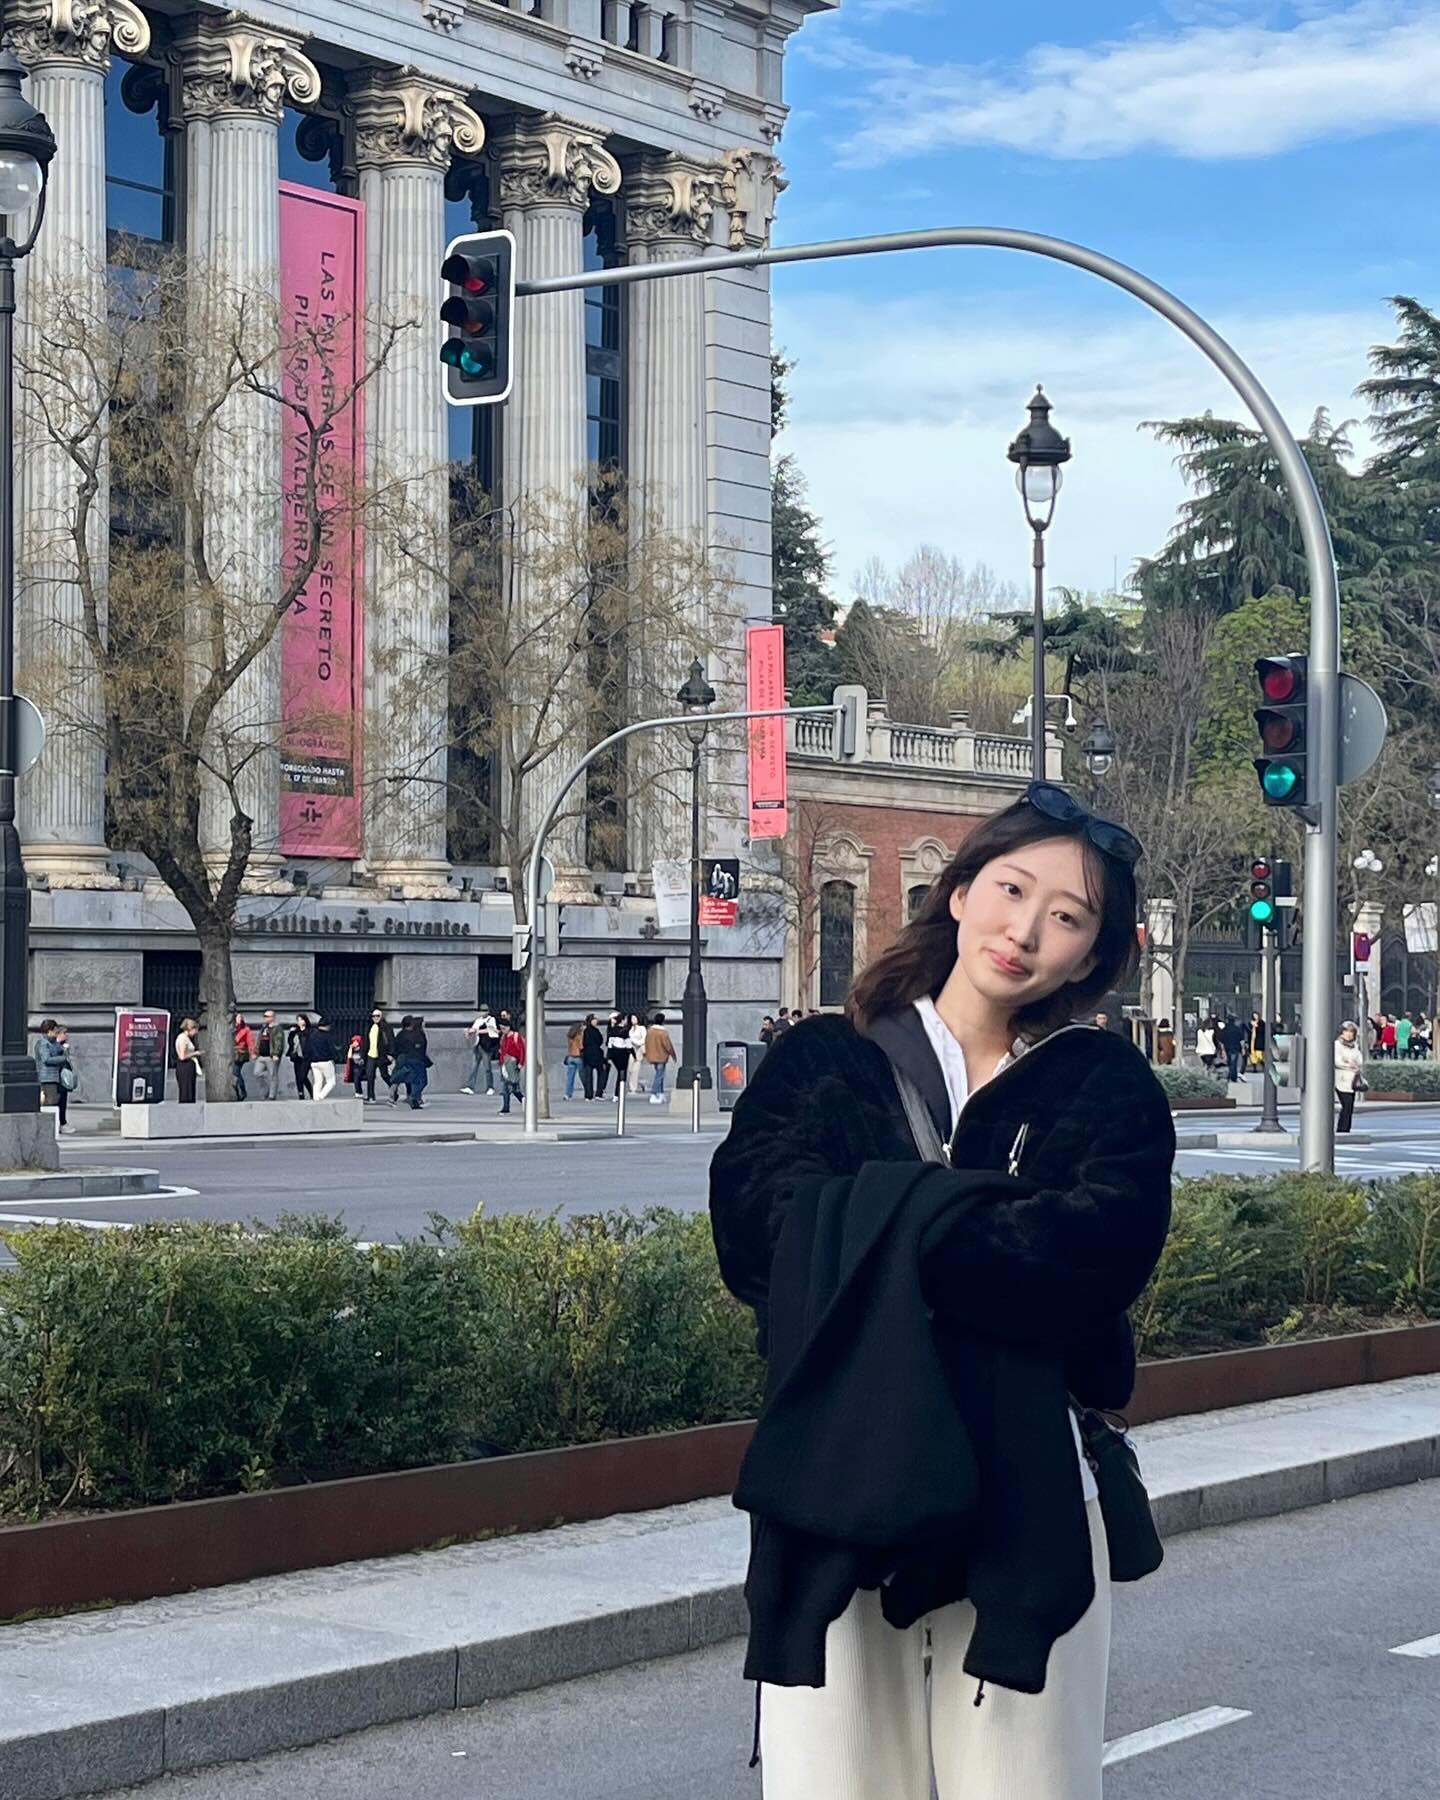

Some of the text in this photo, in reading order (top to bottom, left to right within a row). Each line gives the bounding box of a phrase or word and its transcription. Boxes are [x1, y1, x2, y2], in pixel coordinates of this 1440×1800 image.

[320, 251, 336, 301] LAS
[320, 313, 336, 451] PALABRAS
[320, 463, 335, 498] DE
[317, 560, 335, 682] SECRETO
[759, 703, 767, 760] VADERRAMA
[322, 767, 345, 777] HASTA
[248, 913, 471, 936] Instituto Cervantes
